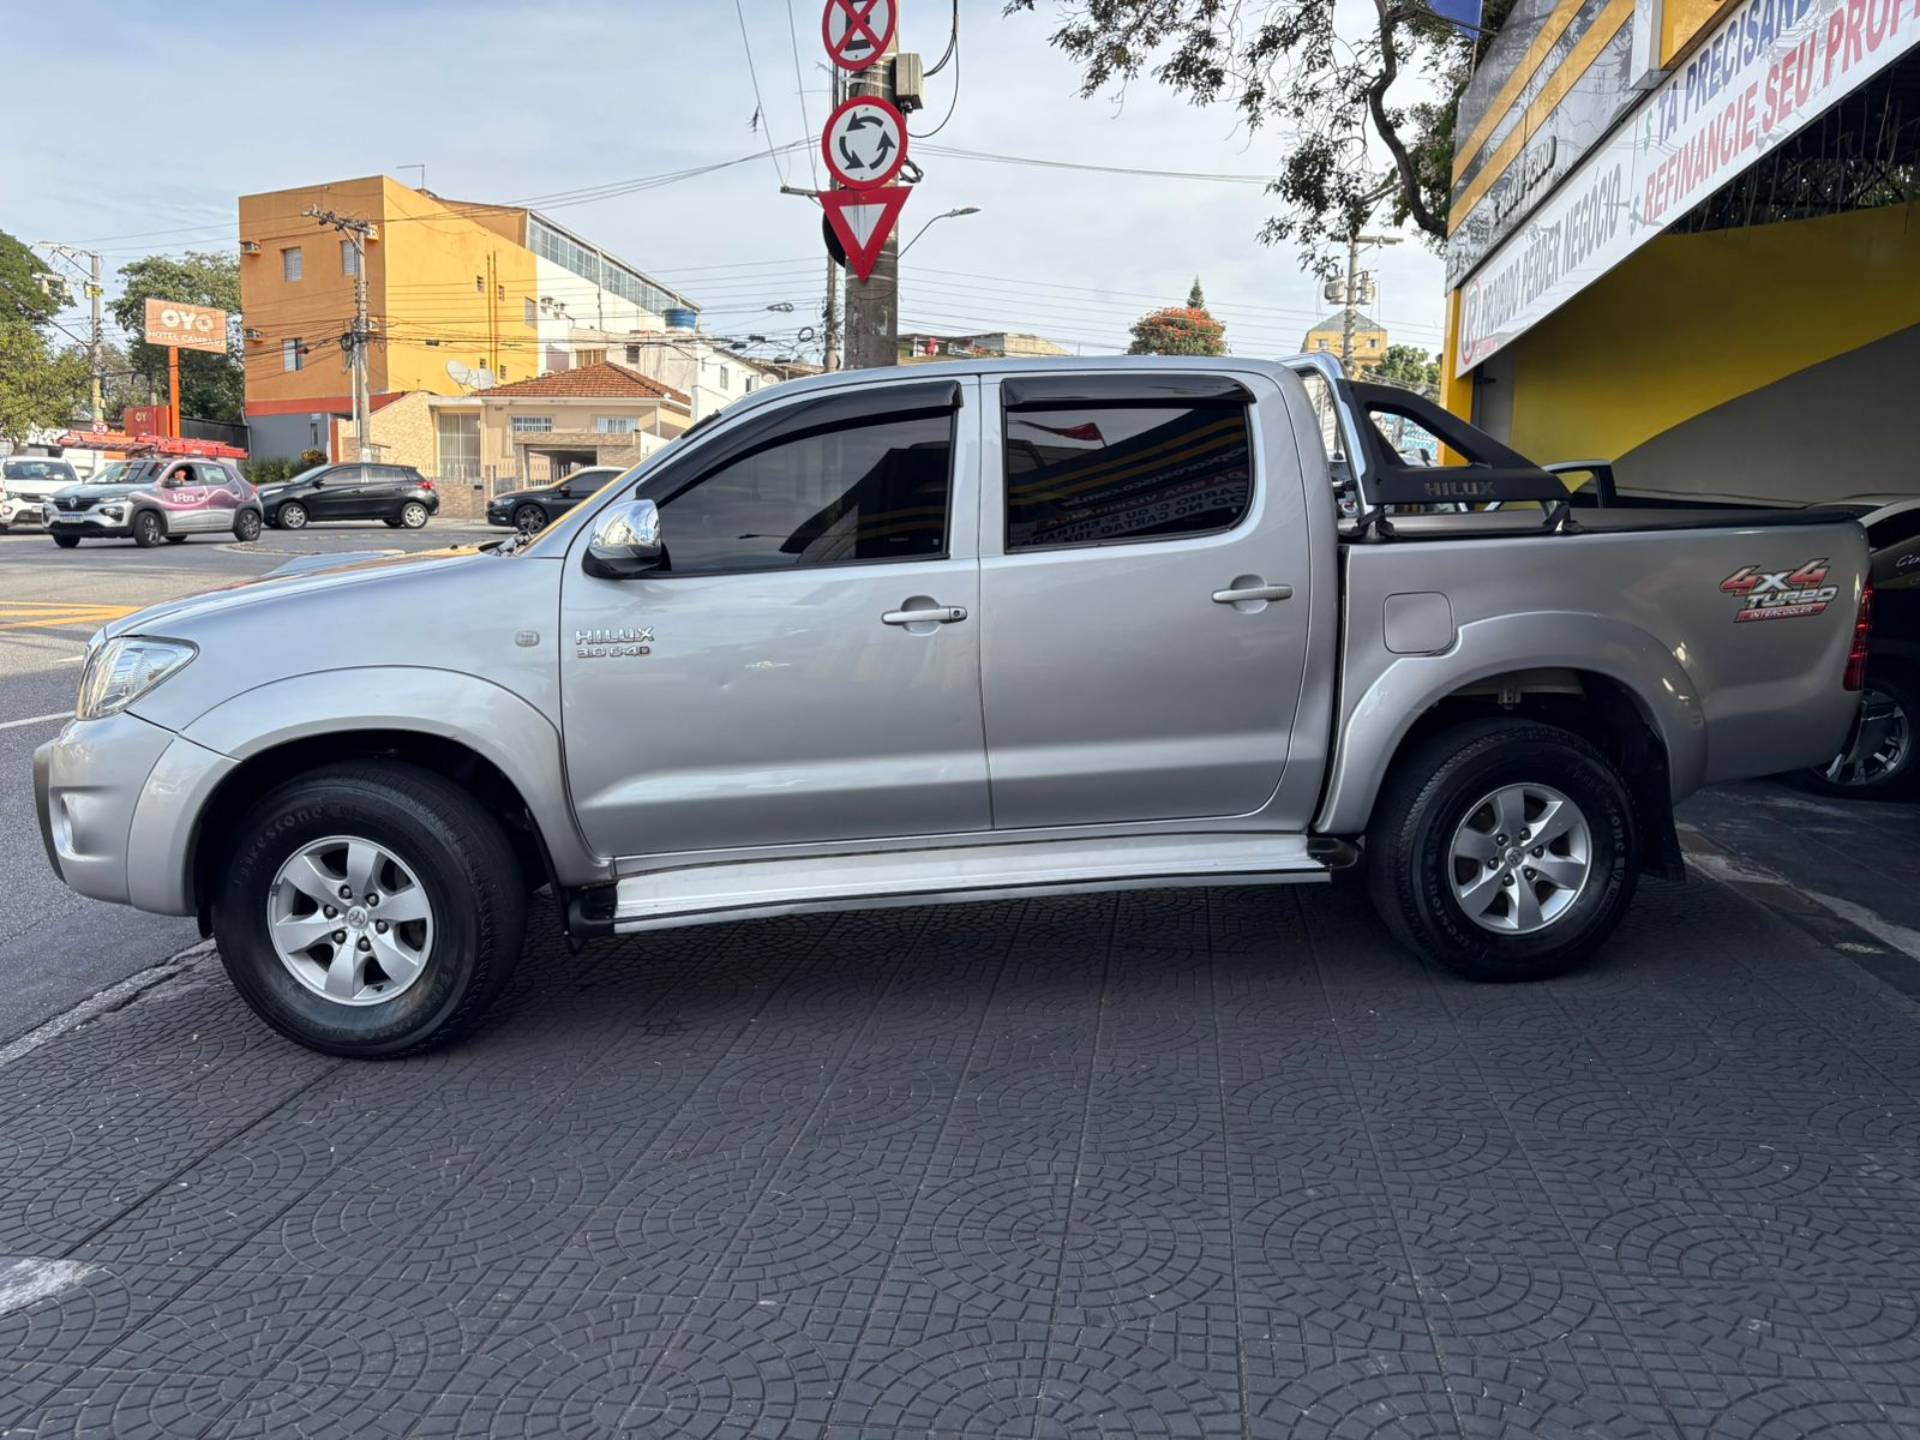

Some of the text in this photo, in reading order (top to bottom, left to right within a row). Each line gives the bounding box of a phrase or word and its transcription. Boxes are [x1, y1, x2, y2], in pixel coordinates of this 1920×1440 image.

[1657, 79, 1678, 146] TA
[1643, 80, 1759, 228] REFINANCIE
[1761, 30, 1818, 134] SEU
[1561, 162, 1622, 277] NEGÓCIO
[160, 308, 215, 333] OYO
[1424, 481, 1496, 497] HILUX
[1747, 586, 1839, 609] TURBO
[575, 625, 655, 645] HILUX
